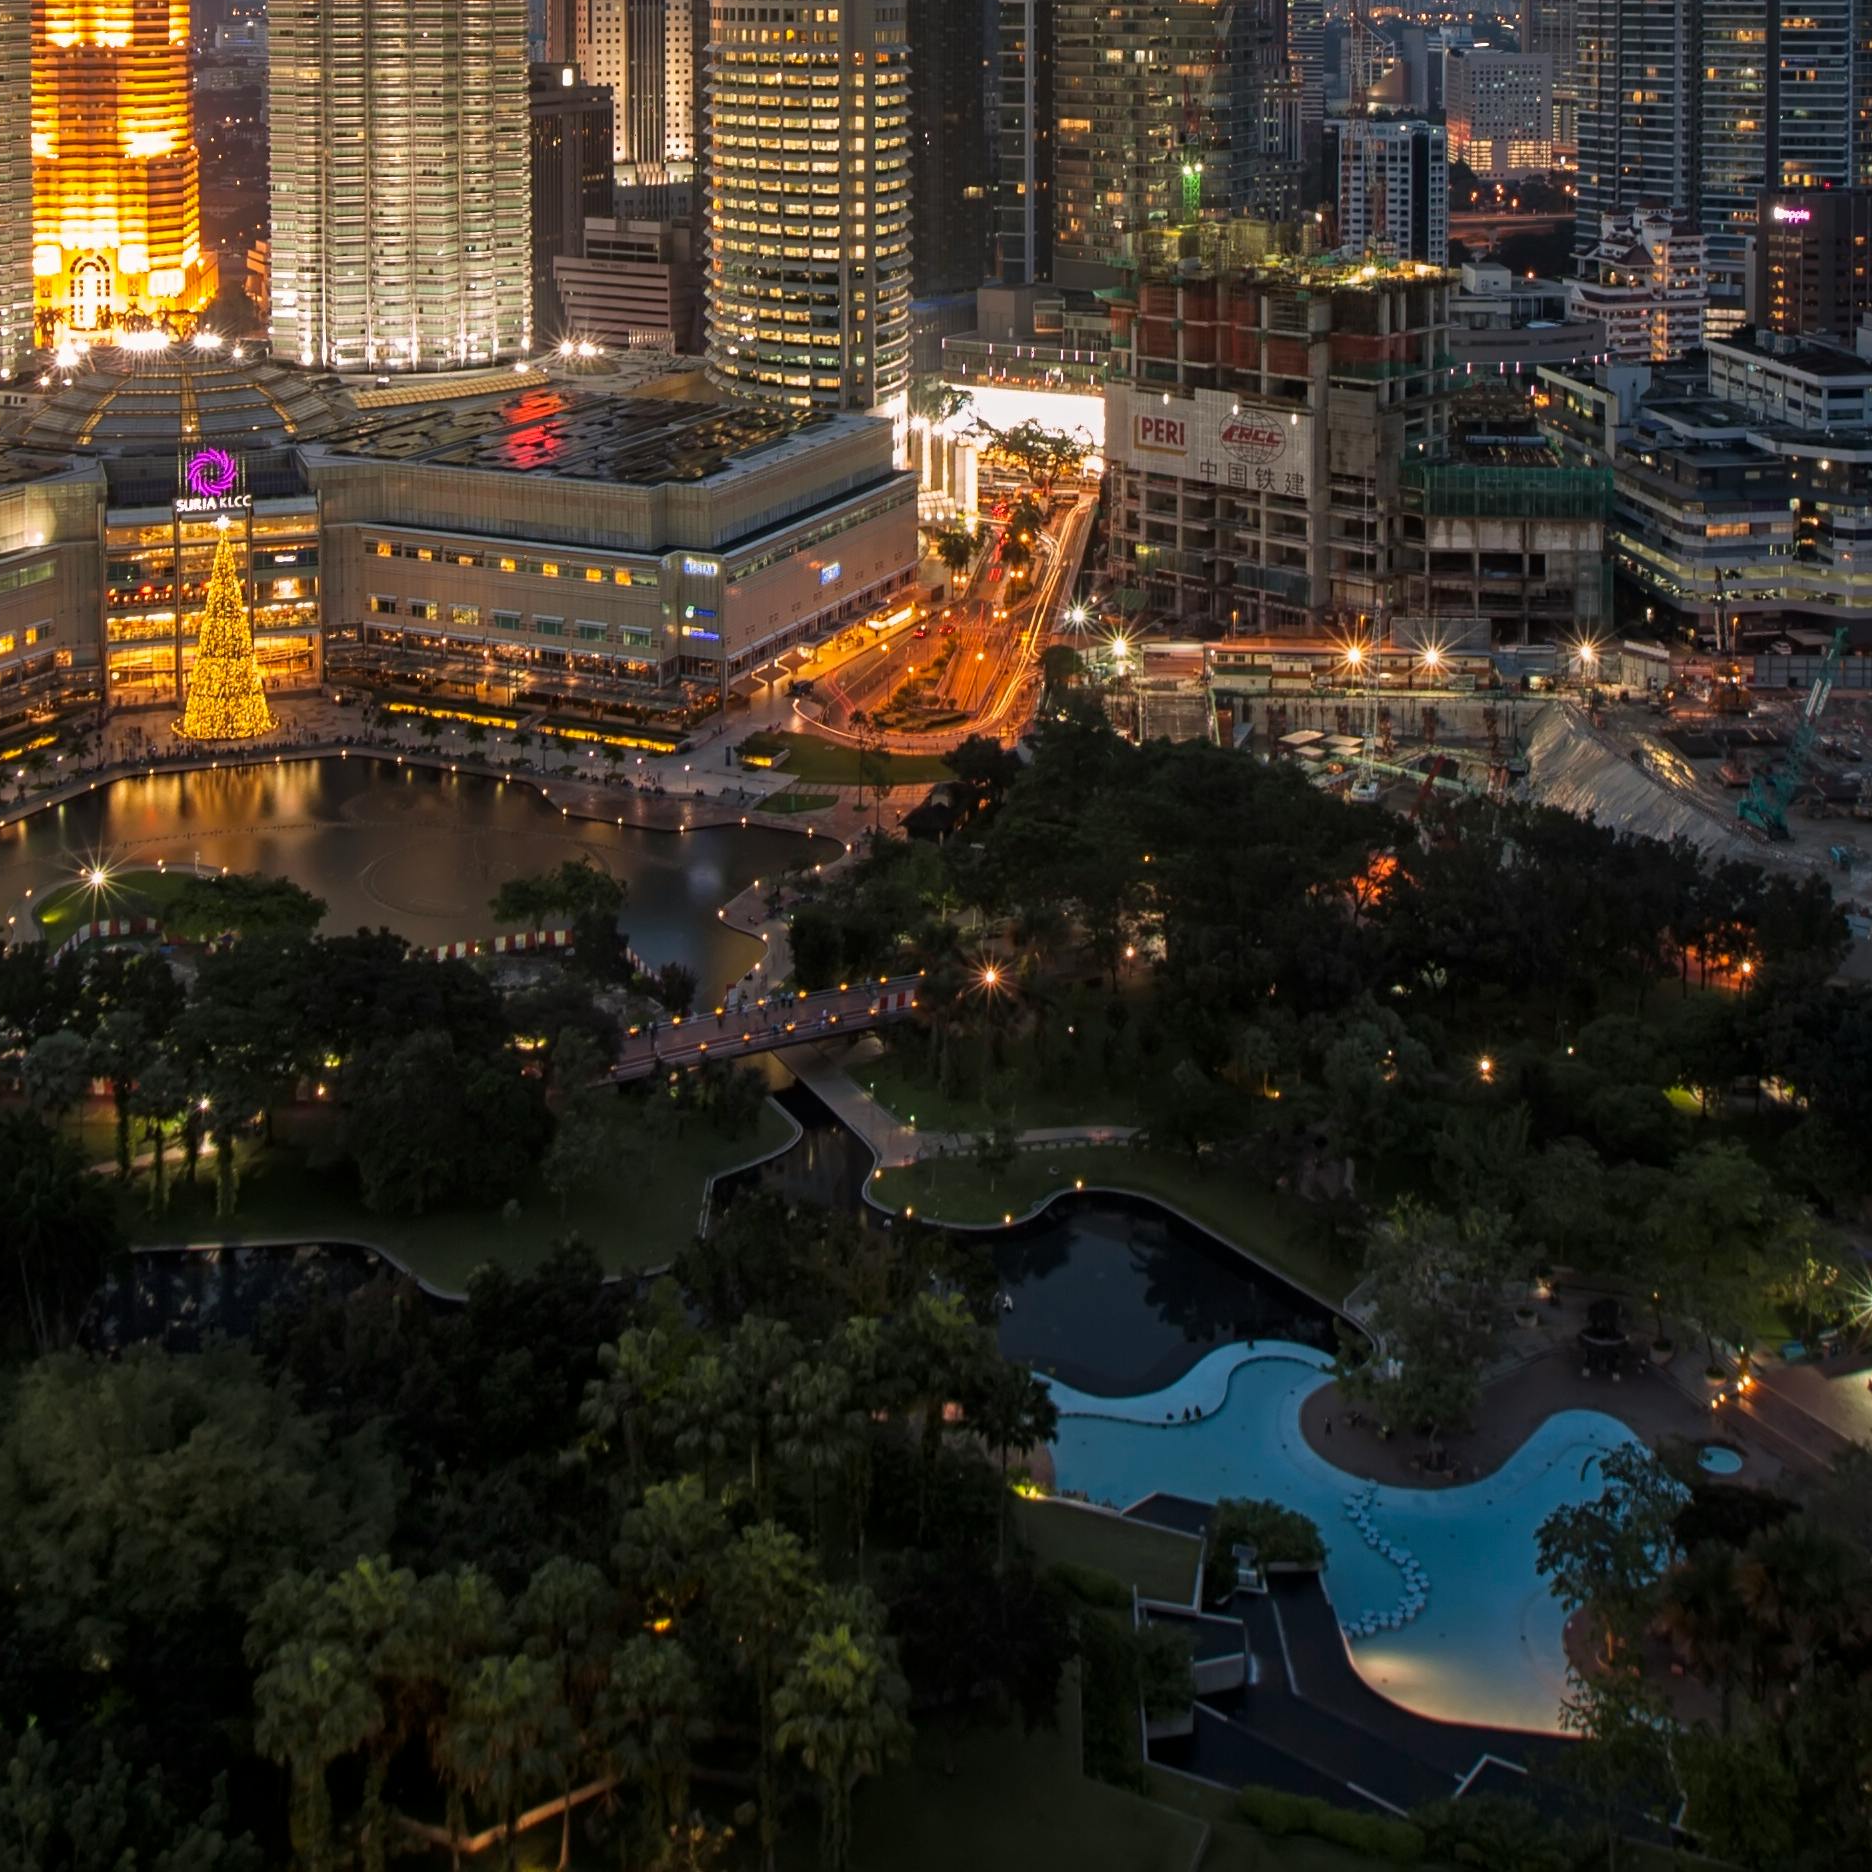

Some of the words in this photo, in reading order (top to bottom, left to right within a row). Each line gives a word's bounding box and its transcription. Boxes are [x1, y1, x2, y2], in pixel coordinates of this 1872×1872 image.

[1141, 416, 1185, 447] PERI
[1200, 458, 1305, 497] 中国铁建
[176, 497, 217, 512] SURIA
[219, 494, 252, 508] KLCC
